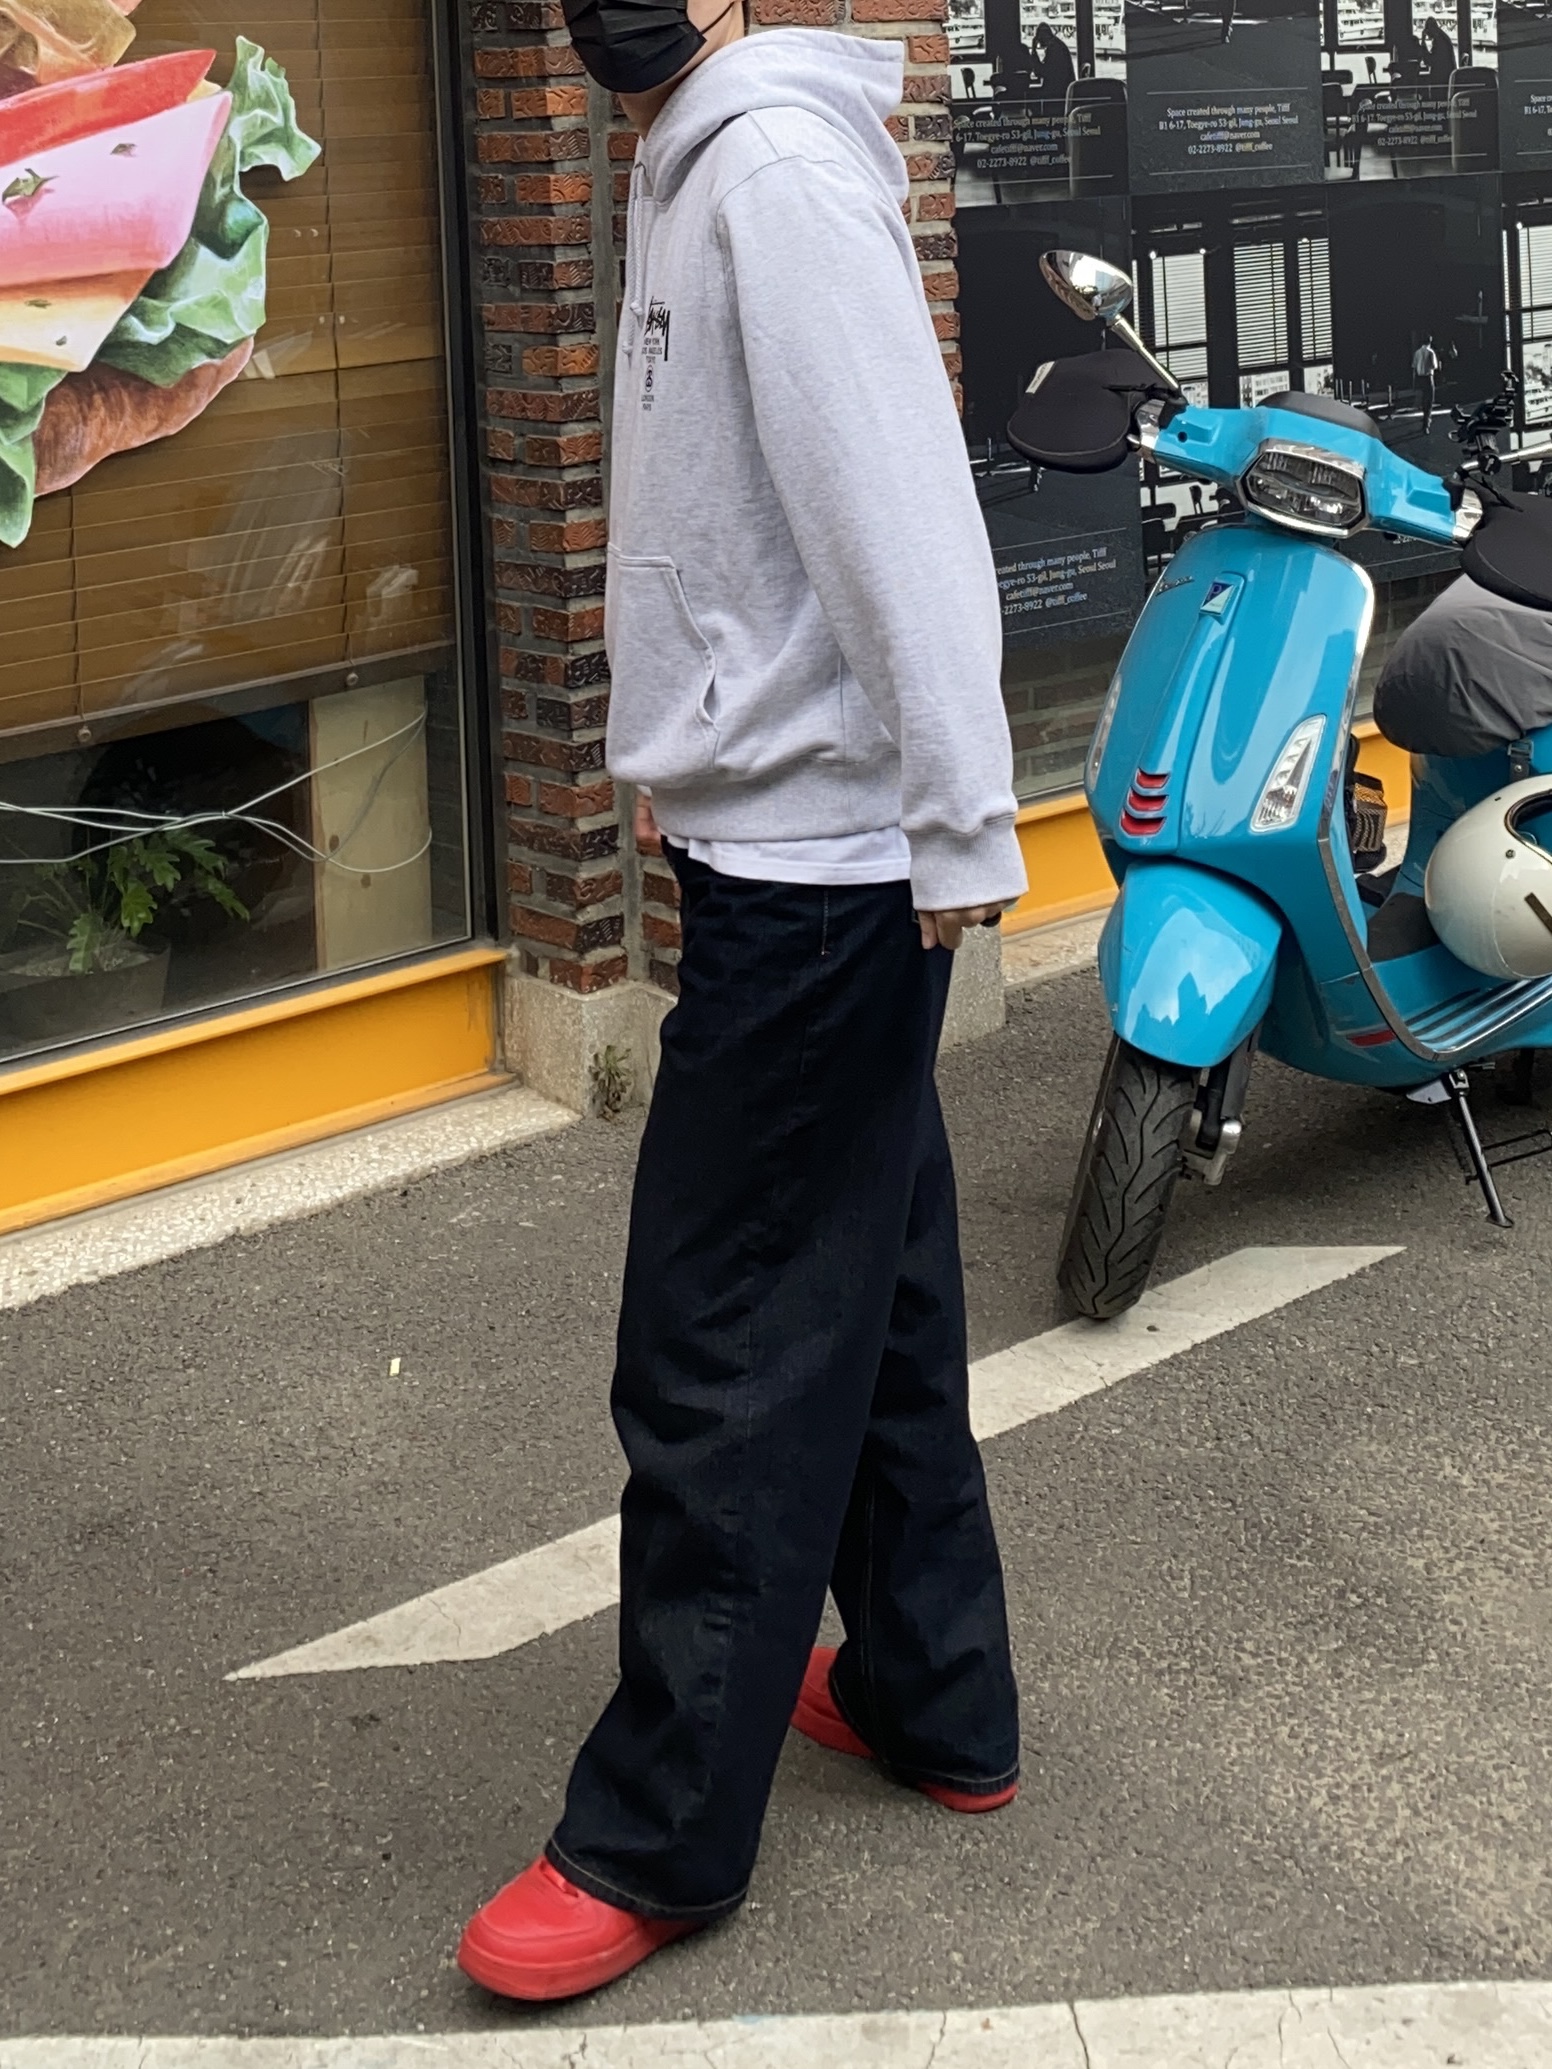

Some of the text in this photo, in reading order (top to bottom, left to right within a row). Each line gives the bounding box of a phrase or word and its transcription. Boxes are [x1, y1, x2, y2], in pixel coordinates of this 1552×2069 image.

[1167, 107, 1186, 119] Space
[1187, 107, 1210, 117] created
[1211, 105, 1235, 117] through
[1237, 105, 1254, 115] many
[1264, 116, 1281, 125] Seoul
[1282, 115, 1299, 124] Seoul
[1017, 557, 1046, 571] through
[1046, 556, 1066, 566] many
[1077, 562, 1097, 574] Seoul
[1097, 558, 1117, 570] Seoul
[1002, 600, 1042, 615] -2273-8922
